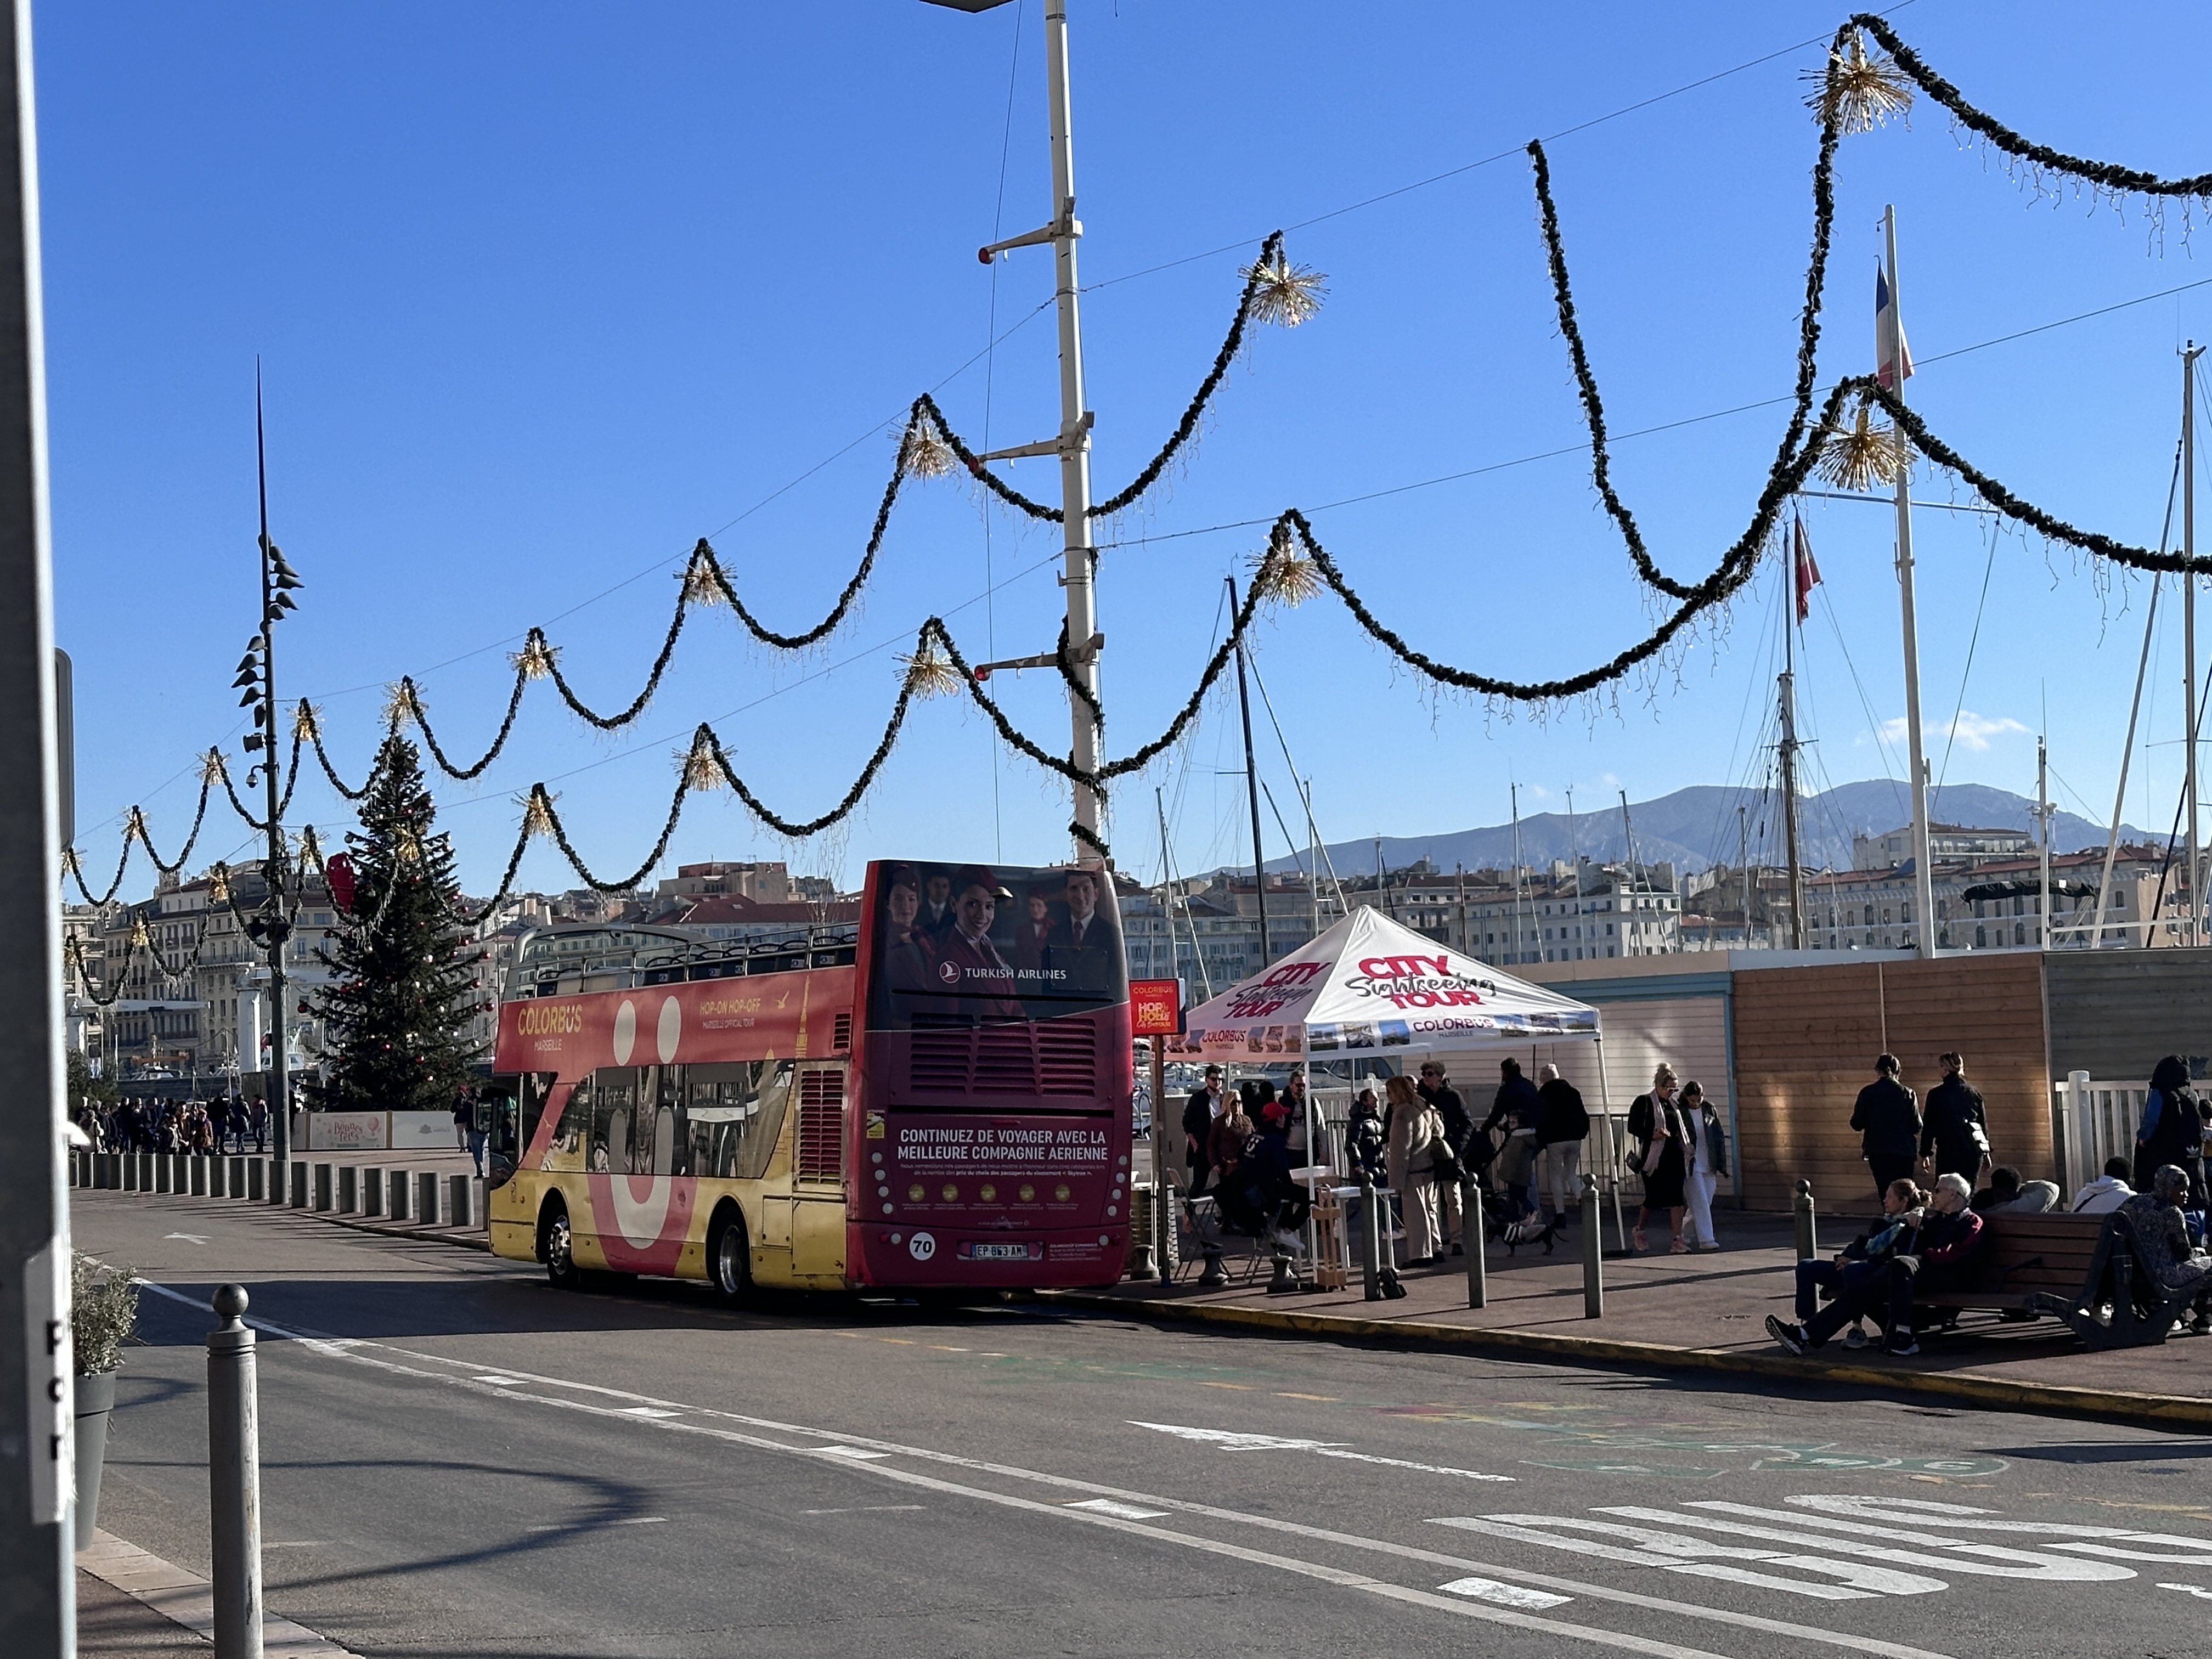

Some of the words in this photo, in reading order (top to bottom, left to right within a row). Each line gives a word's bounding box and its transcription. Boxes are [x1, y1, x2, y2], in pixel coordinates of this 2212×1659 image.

[965, 968, 1014, 978] TURKISH
[1017, 969, 1066, 979] AIRLINES
[1263, 962, 1332, 986] CITY
[1359, 955, 1452, 979] CITY
[699, 1000, 728, 1015] HOP-ON
[729, 998, 761, 1014] HOP-OFF
[1381, 991, 1486, 1009] TOUR
[1223, 1001, 1284, 1019] TOUR
[900, 1129, 974, 1142] CONTINUEZ
[978, 1130, 994, 1143] DE
[997, 1130, 1053, 1143] VOYAGER
[1056, 1130, 1086, 1144] AVEC
[1091, 1130, 1106, 1144] LA
[898, 1146, 968, 1160] MEILLEURE
[972, 1146, 1045, 1160] COMPAGNIE
[1048, 1147, 1108, 1160] AERIENNE
[913, 1240, 932, 1253] 70
